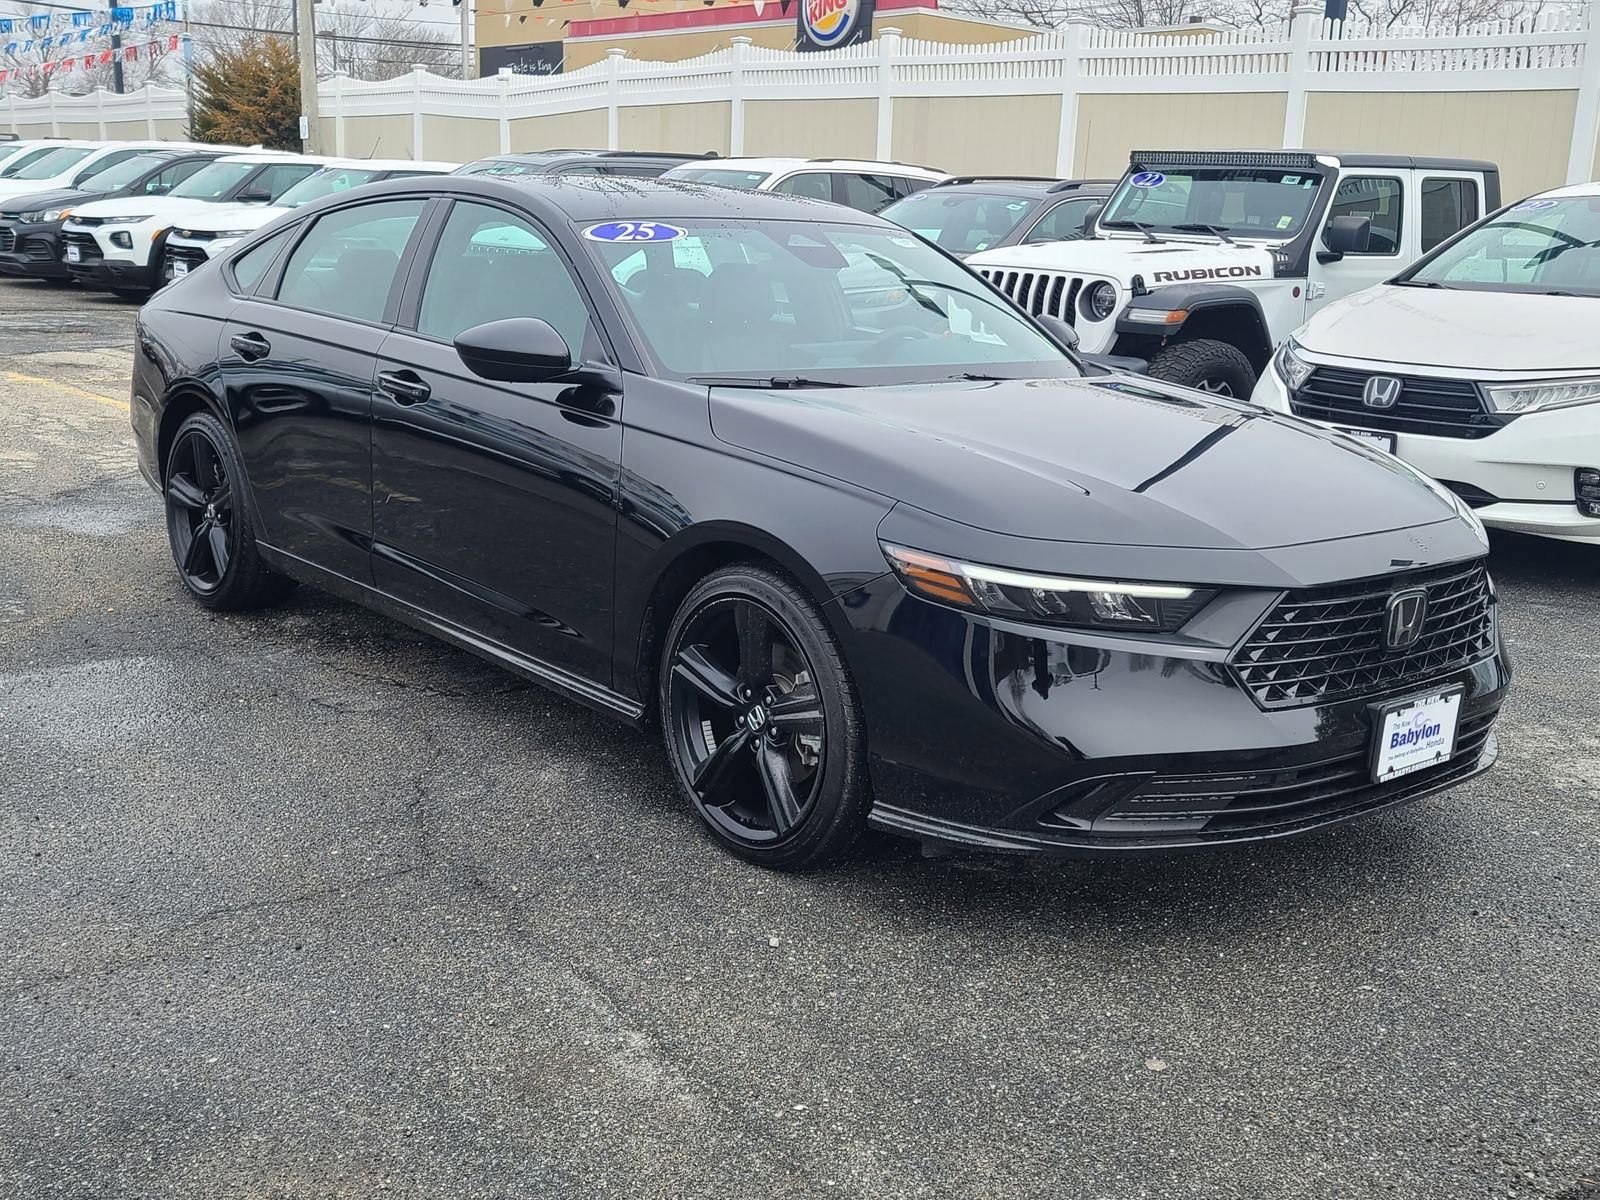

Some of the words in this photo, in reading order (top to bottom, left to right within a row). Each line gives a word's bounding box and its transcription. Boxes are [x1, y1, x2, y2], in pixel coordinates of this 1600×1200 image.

[1137, 173, 1159, 186] 22
[614, 223, 656, 241] 25
[1153, 265, 1261, 283] RUBICON
[1390, 723, 1441, 749] Babylon
